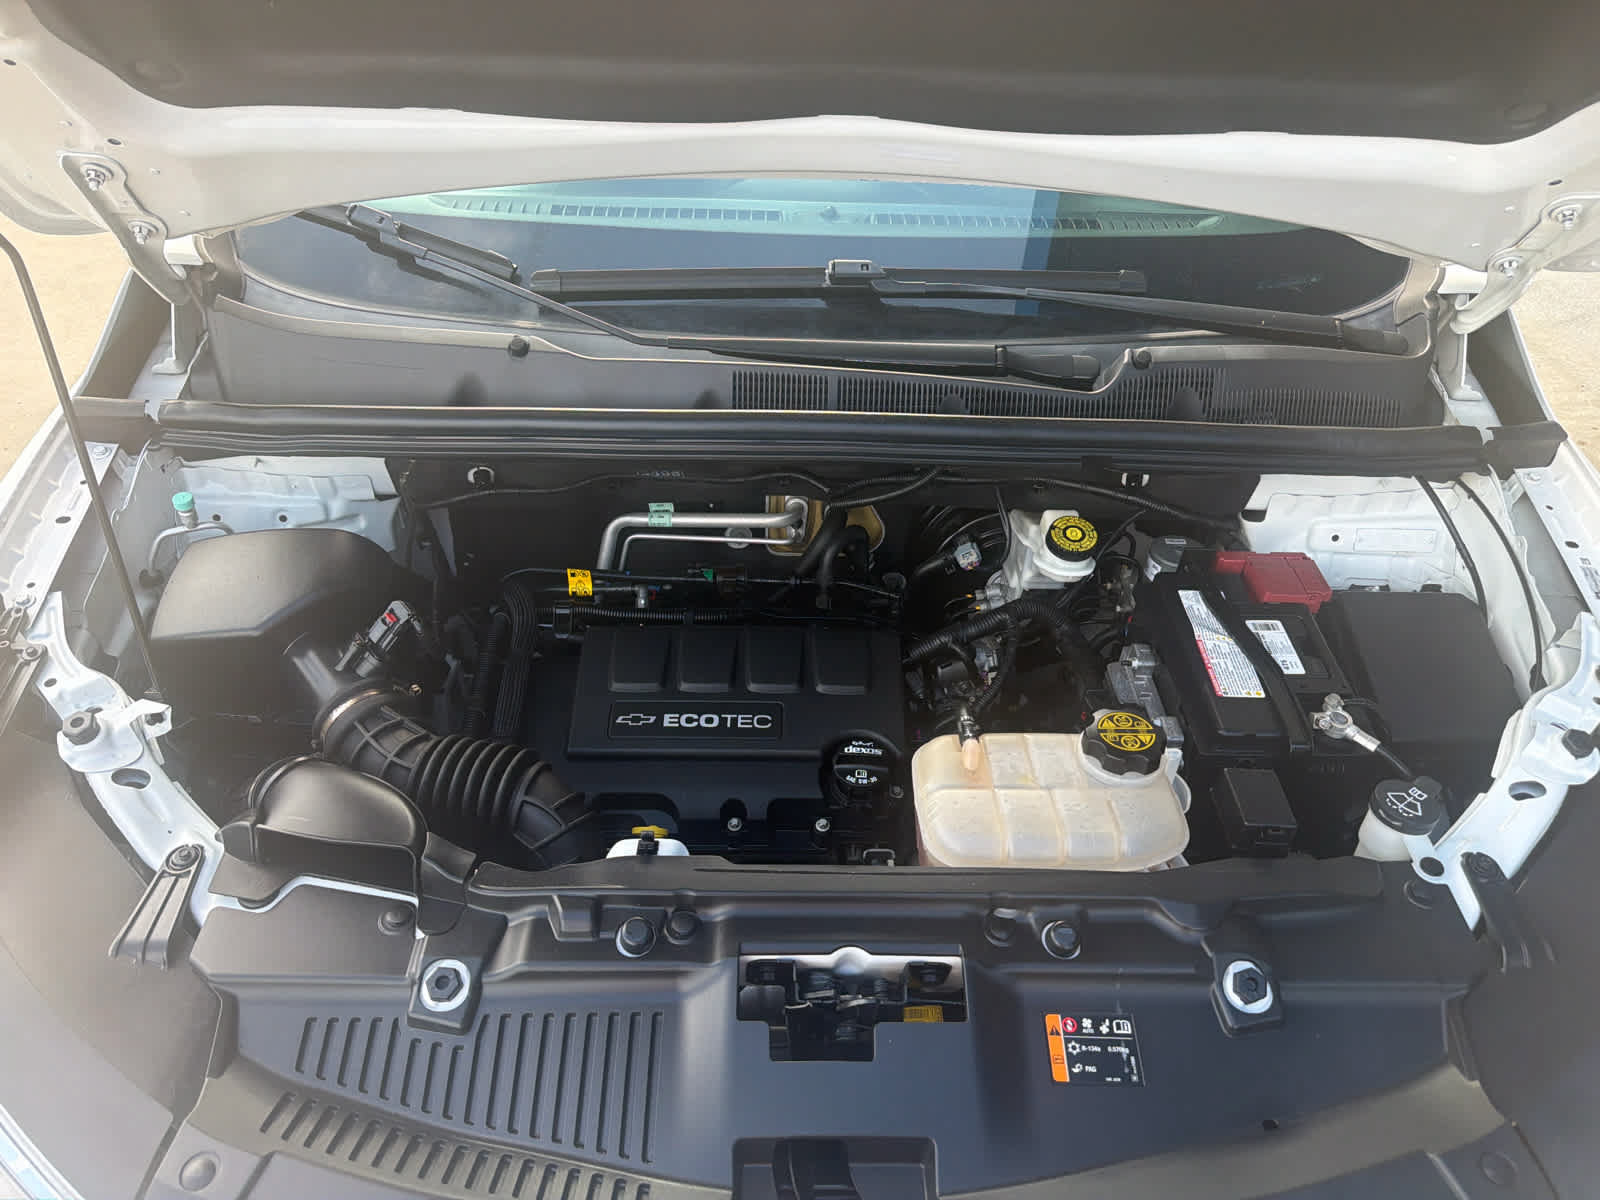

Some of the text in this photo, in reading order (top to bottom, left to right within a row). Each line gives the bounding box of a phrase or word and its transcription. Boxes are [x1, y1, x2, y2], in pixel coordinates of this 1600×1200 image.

[663, 713, 773, 729] ECOTEC
[844, 745, 882, 755] dexos
[1085, 1065, 1097, 1073] PAG
